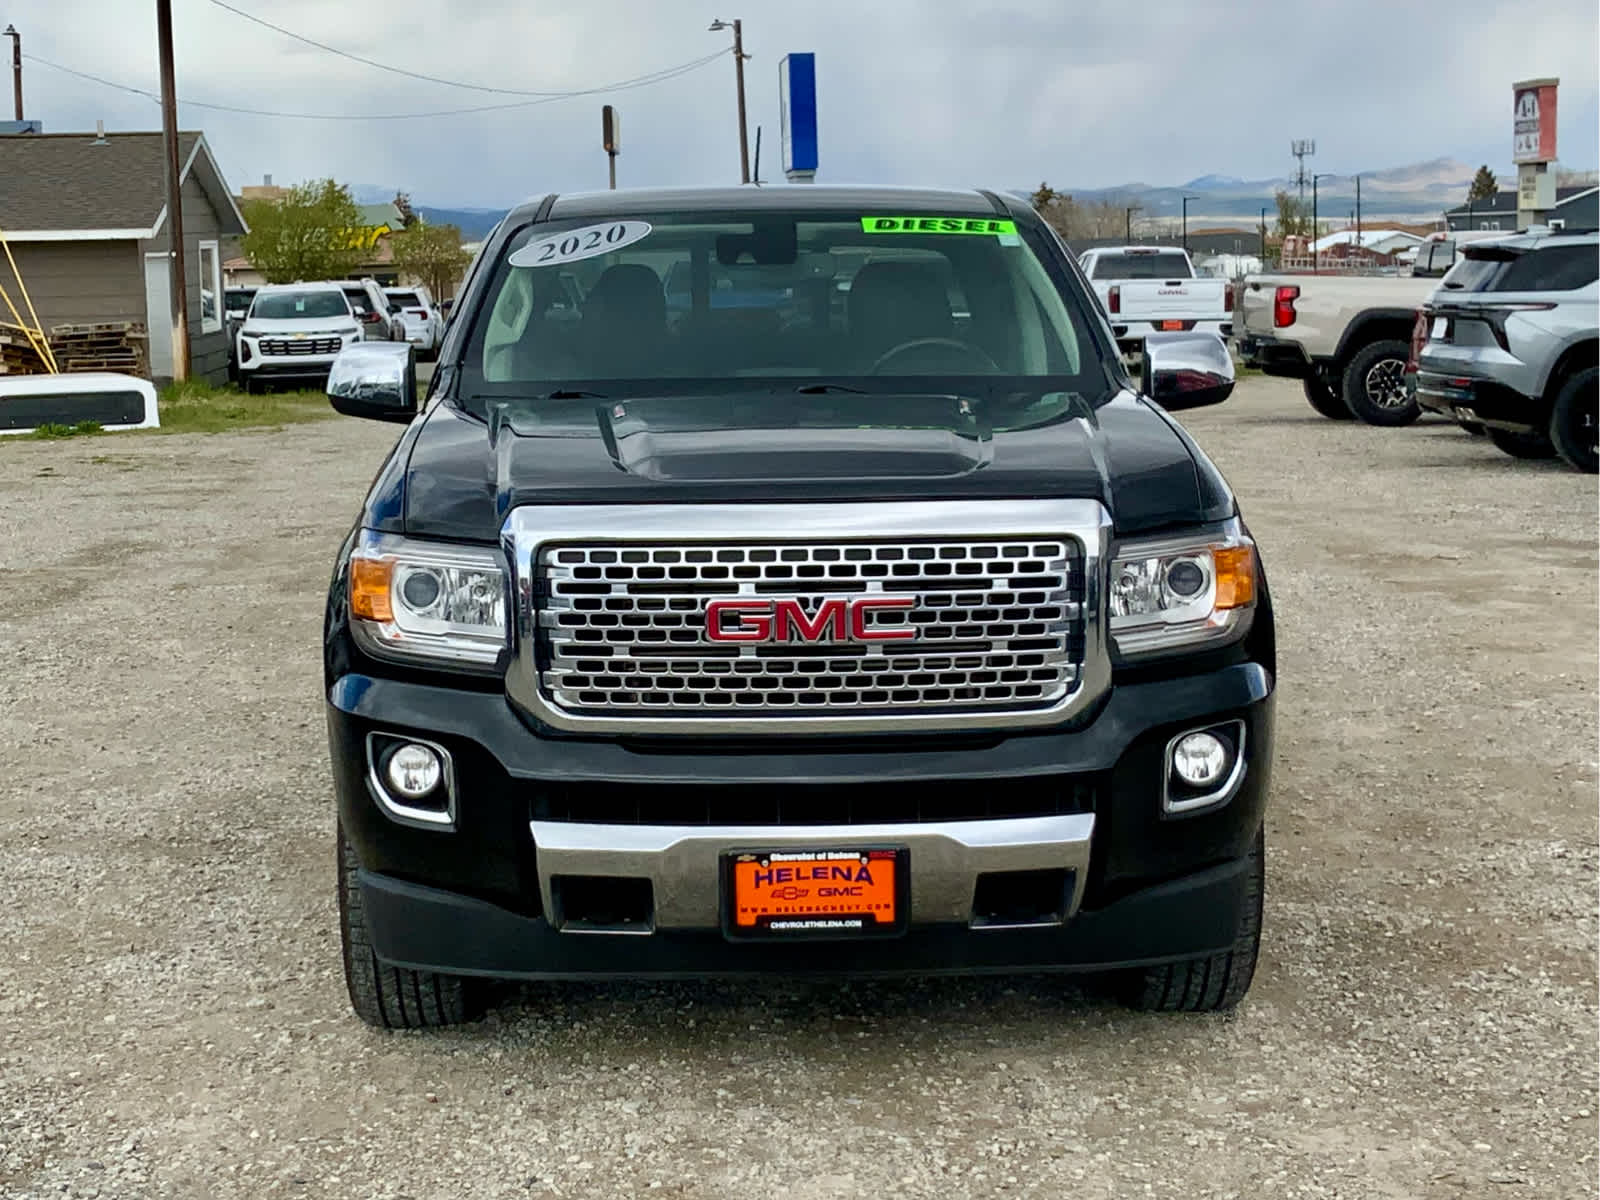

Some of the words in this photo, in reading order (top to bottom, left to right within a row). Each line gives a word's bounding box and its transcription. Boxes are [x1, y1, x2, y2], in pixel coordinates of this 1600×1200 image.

[874, 219, 1007, 233] DIESEL
[537, 224, 626, 263] 2020
[705, 597, 917, 643] GMC
[754, 866, 874, 888] HELENA
[818, 887, 863, 897] GMC
